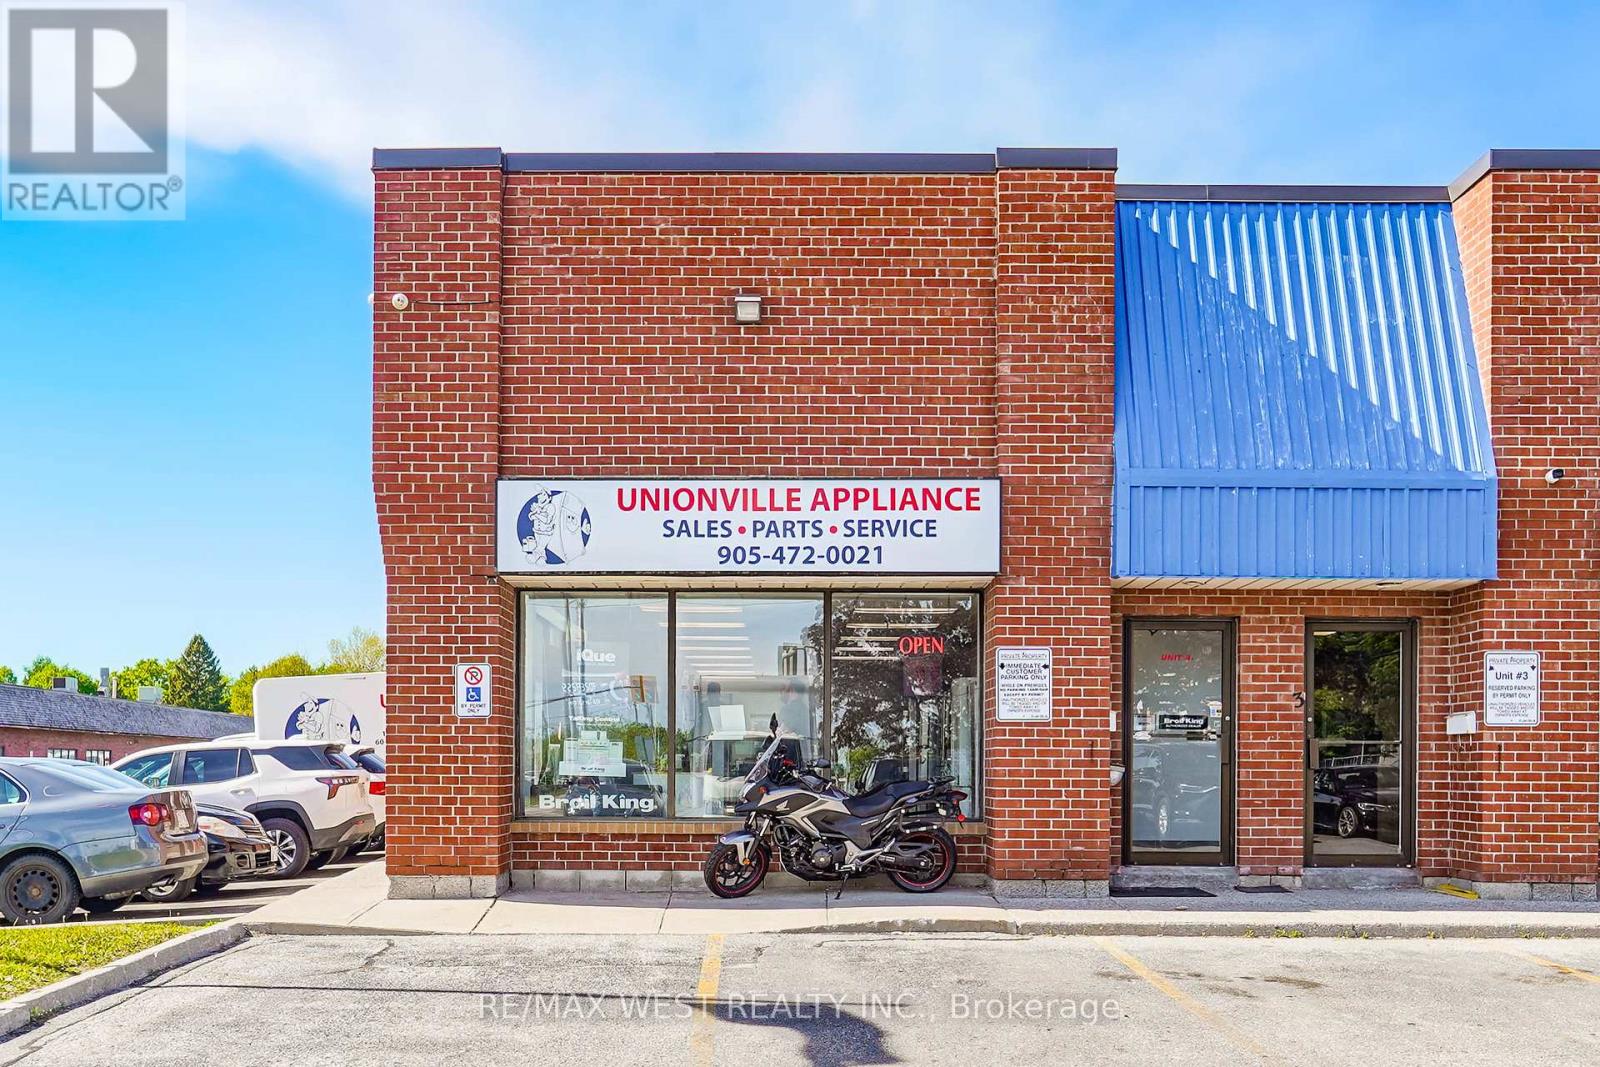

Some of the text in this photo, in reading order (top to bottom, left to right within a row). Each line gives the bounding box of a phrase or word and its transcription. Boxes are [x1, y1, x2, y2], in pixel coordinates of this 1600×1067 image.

[616, 487, 981, 512] UNIONVILLE APPLIANCE
[662, 519, 937, 538] SALES PARTS SERVICE
[717, 545, 883, 565] 905-472-0021
[898, 636, 945, 655] OPEN
[1495, 671, 1529, 680] Unit #3
[1293, 691, 1304, 708] 3
[602, 794, 655, 813] King
